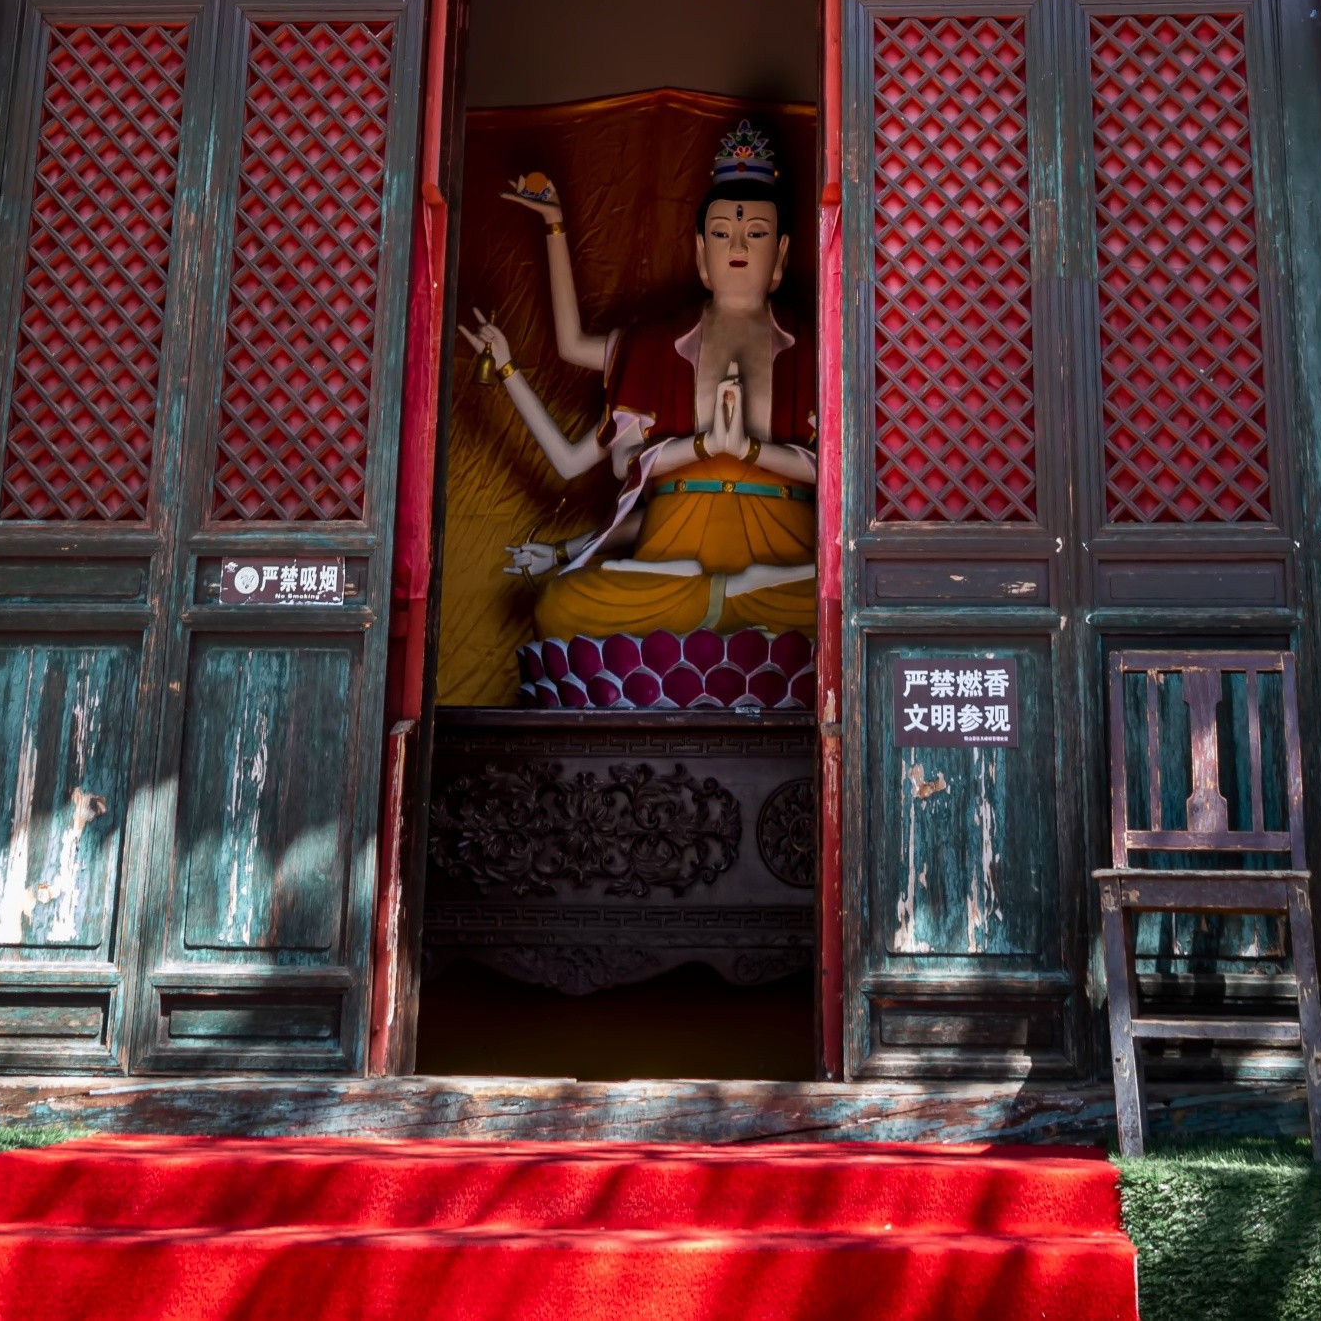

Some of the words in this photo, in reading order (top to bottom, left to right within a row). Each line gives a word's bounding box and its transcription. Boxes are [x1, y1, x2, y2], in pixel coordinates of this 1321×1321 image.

[260, 565, 338, 593] 严禁吸烟
[903, 669, 1009, 698] 严禁燃香
[903, 704, 1011, 733] 文明参观
